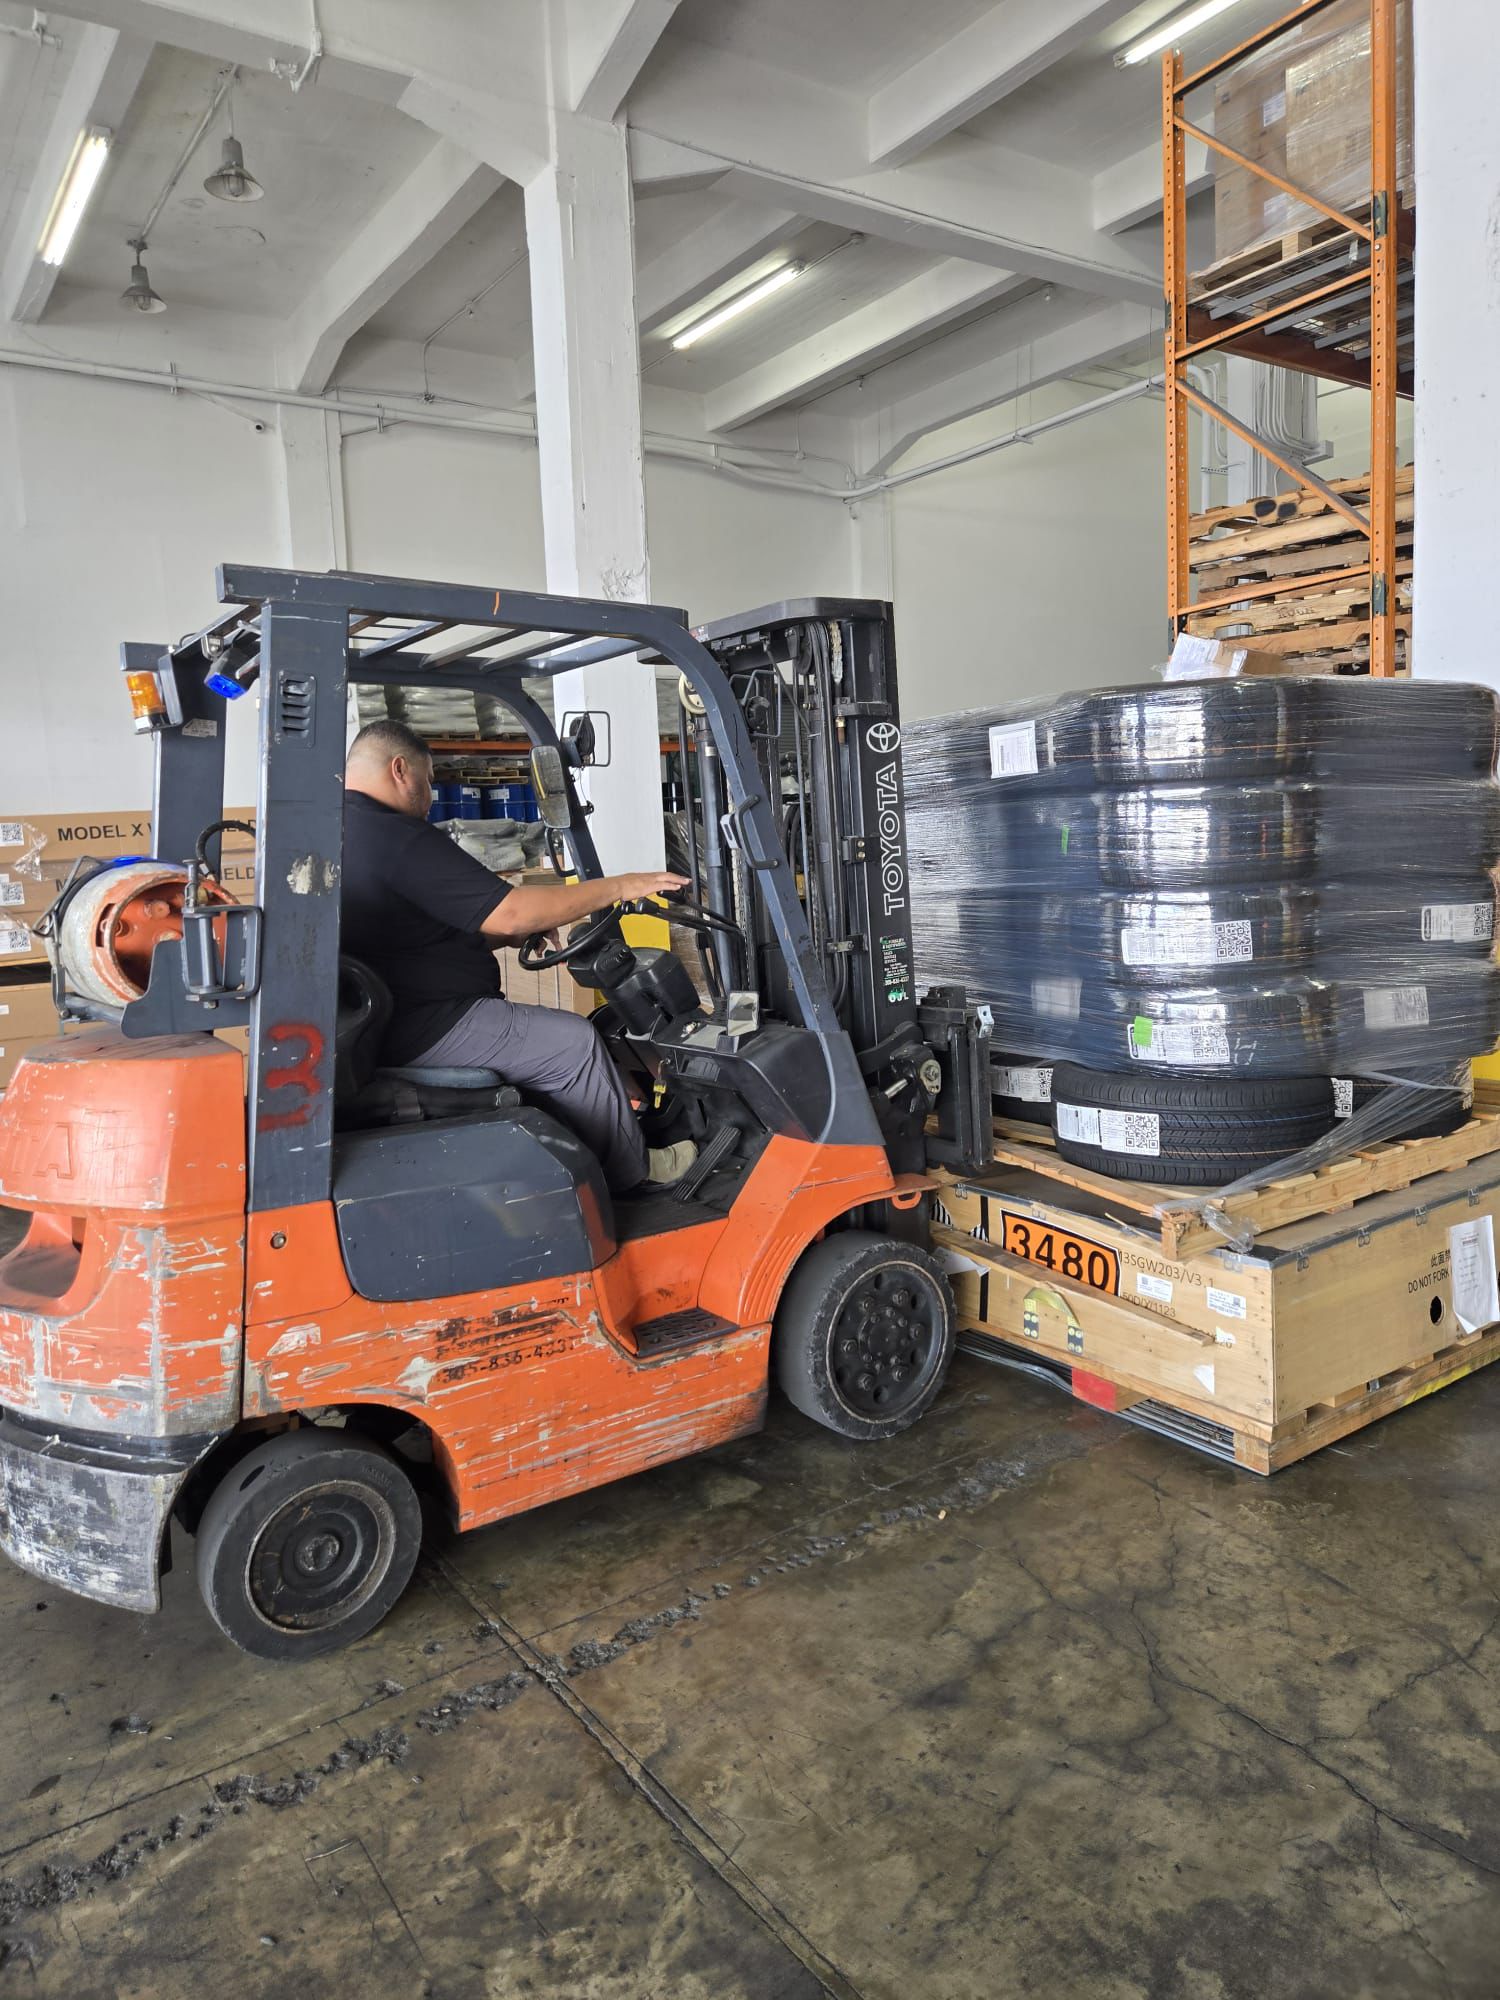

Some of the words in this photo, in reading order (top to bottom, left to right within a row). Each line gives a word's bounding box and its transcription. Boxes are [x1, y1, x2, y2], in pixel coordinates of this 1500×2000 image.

[58, 825, 126, 841] MODEL
[131, 823, 144, 837] X
[875, 761, 905, 916] TOYOTA
[258, 1022, 325, 1133] 3
[1010, 1223, 1110, 1291] 3480
[1408, 1280, 1418, 1294] DO
[1419, 1274, 1432, 1288] NOT
[1433, 1268, 1450, 1284] FORK
